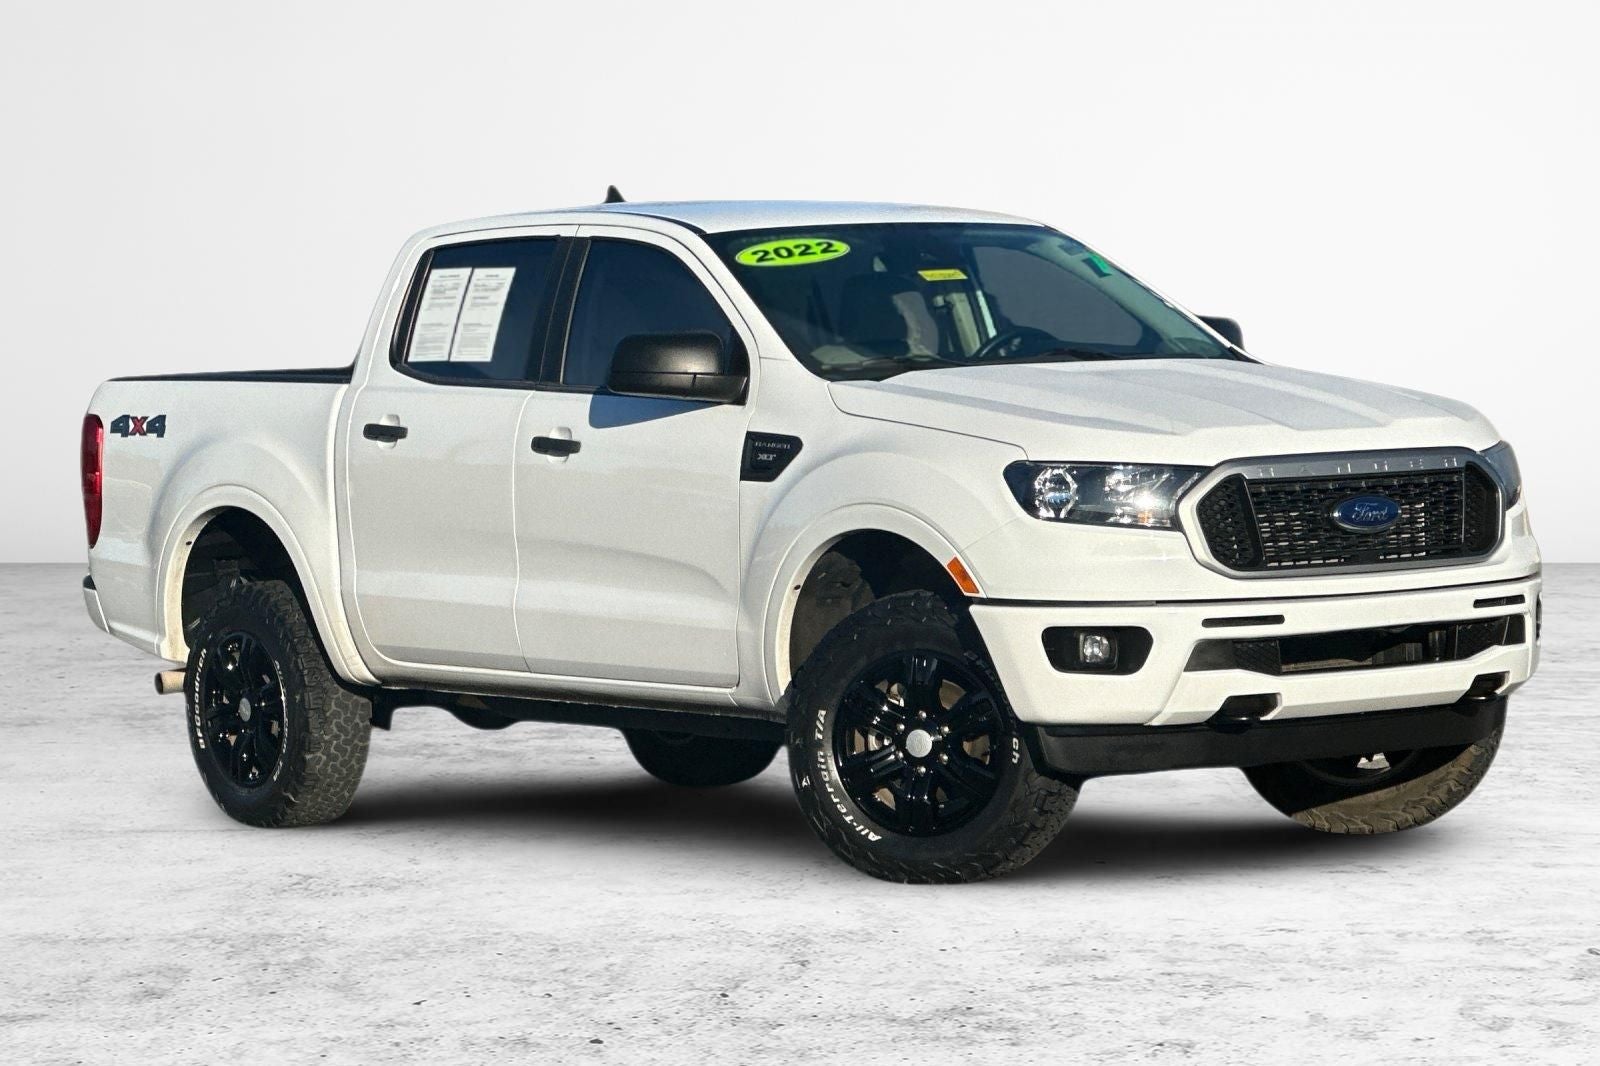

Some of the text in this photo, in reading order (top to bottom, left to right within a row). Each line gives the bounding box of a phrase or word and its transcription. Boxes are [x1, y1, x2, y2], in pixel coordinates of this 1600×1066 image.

[751, 241, 840, 263] 2022
[757, 453, 777, 461] XLT
[1351, 502, 1389, 522] Ford
[814, 709, 883, 842] All-Terrain T/A
